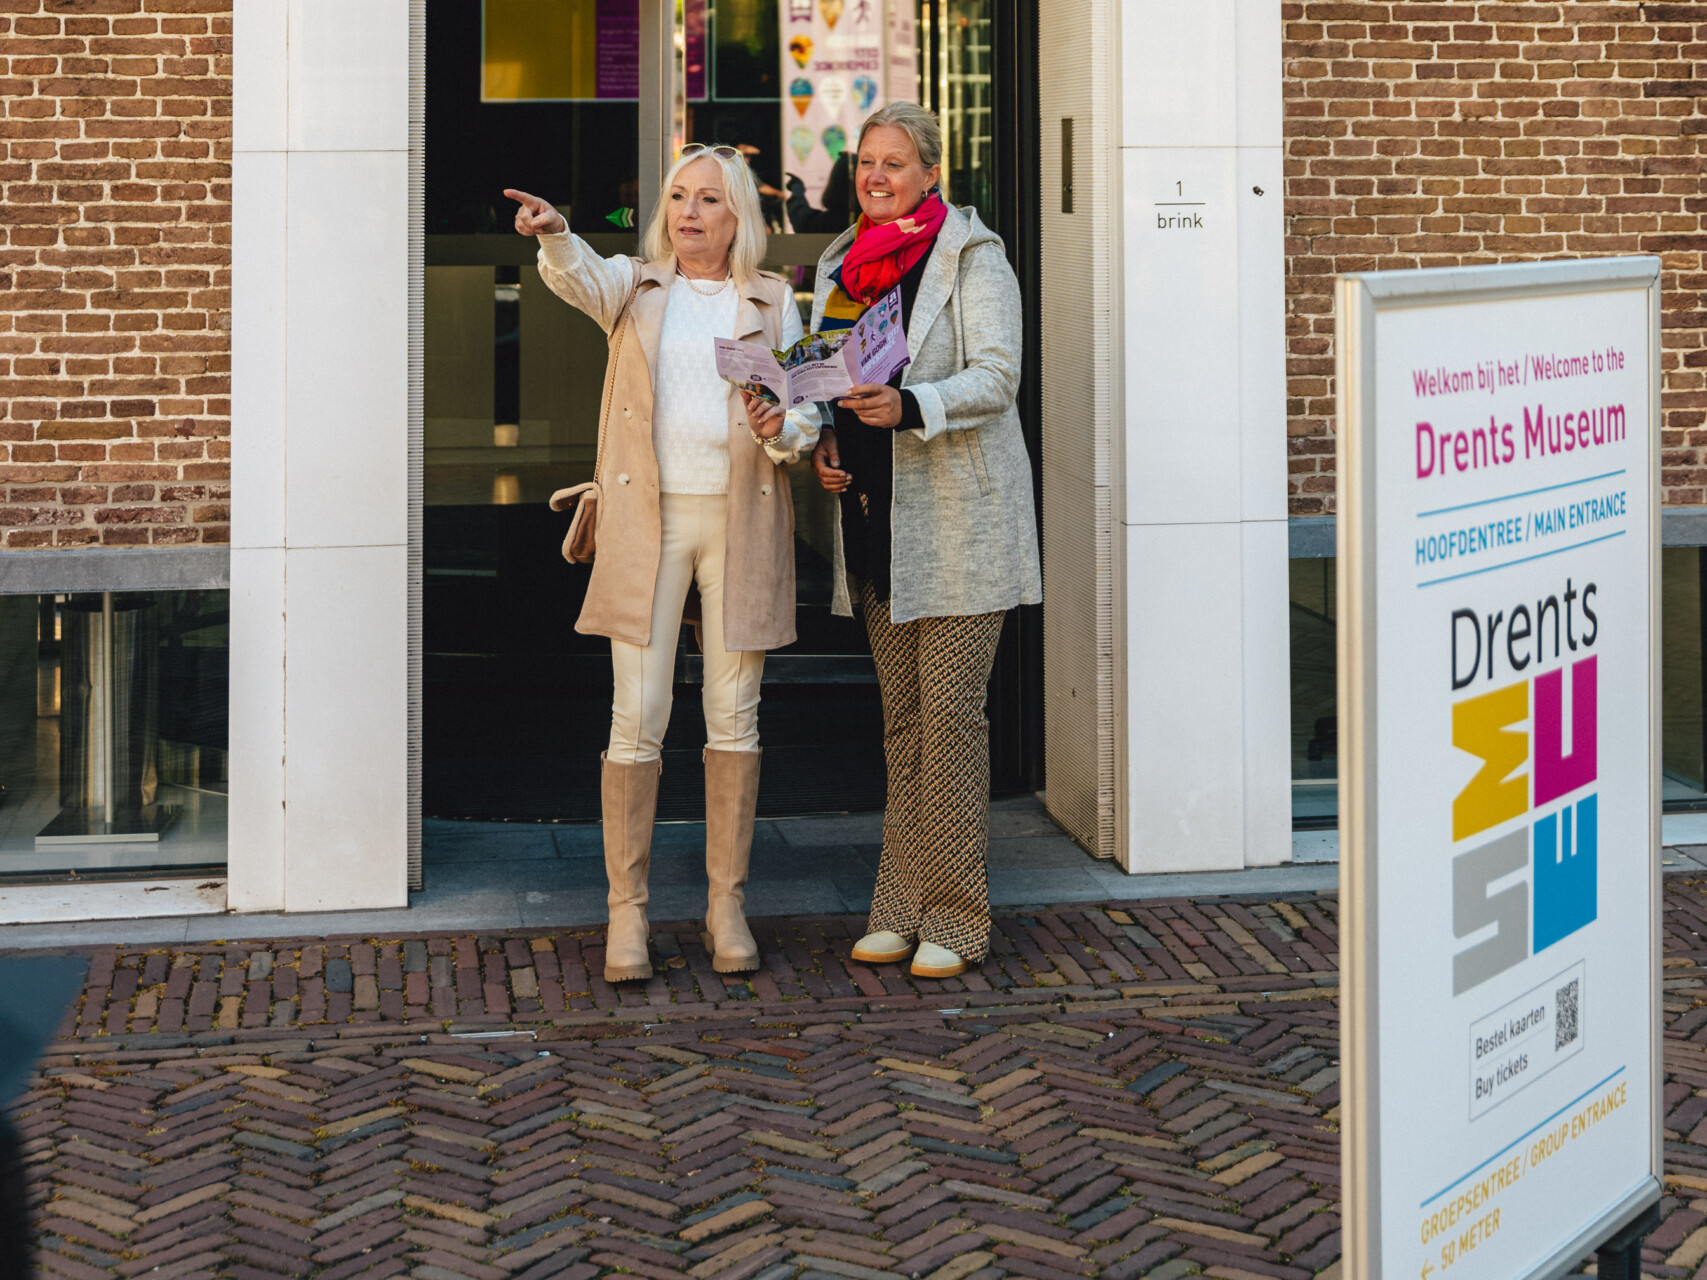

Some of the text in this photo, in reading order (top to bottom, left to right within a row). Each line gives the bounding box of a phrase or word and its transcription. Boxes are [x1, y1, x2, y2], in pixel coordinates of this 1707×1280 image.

[1176, 180, 1182, 197] 1
[1157, 212, 1204, 229] brink
[872, 338, 888, 358] GOGH
[1413, 368, 1475, 397] Welkom
[1478, 361, 1495, 395] bij
[1498, 360, 1520, 386] het
[1531, 353, 1589, 381] Welcome
[1592, 349, 1603, 373] to
[1606, 345, 1625, 371] the
[1416, 403, 1626, 479] Drents Museum
[1415, 517, 1522, 565] HOOFDENTREE
[1534, 506, 1566, 537] MAIN
[1569, 490, 1626, 528] ENTRANCE
[1451, 577, 1598, 691] Drents
[1475, 1005, 1545, 1060] Bestel kaarten
[1475, 1053, 1529, 1100] Buy tickets
[1421, 1155, 1520, 1246] GROEPSENTREE
[1530, 1122, 1569, 1168] GROUP
[1571, 1081, 1627, 1140] ENTRANCE
[1441, 1207, 1500, 1271] 50 METER
